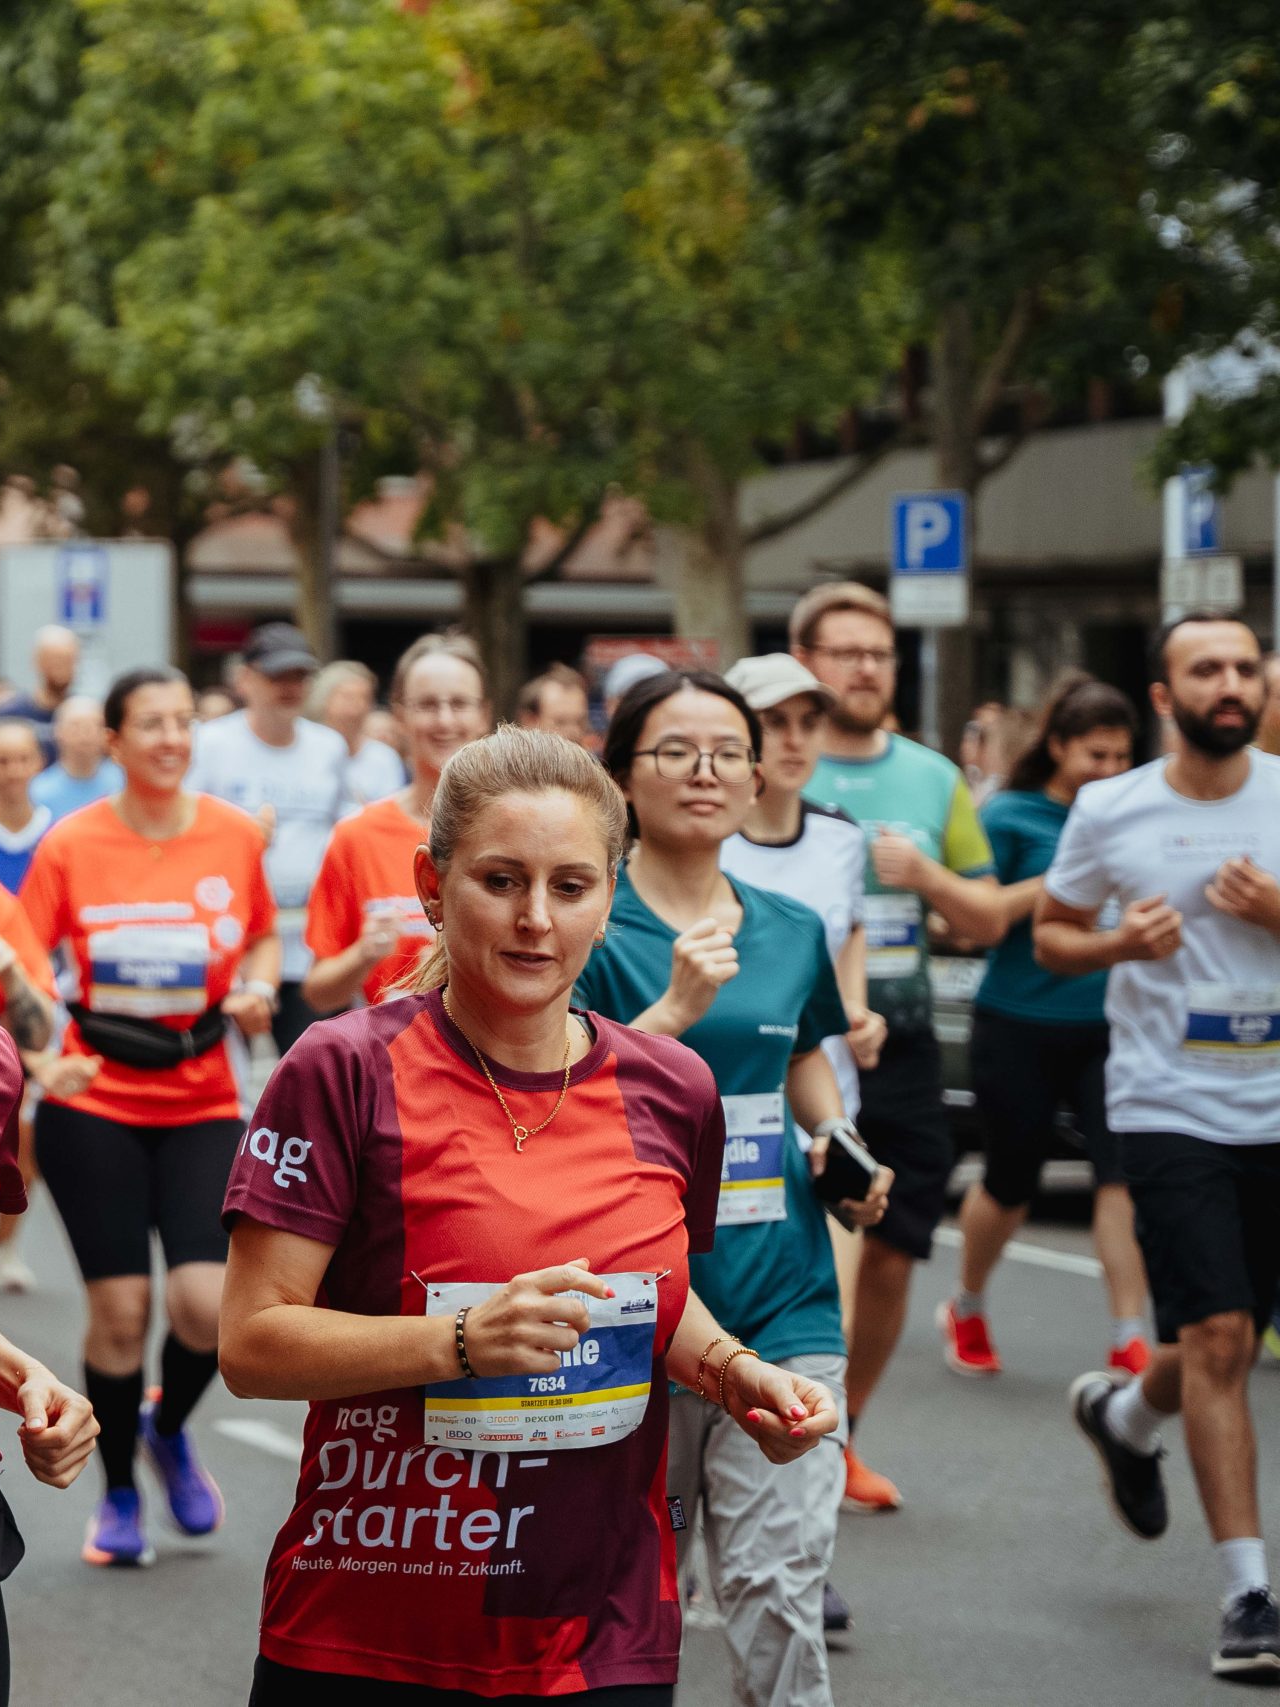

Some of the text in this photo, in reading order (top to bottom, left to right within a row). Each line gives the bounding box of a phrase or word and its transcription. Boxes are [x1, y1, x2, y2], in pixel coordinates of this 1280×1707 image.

[904, 500, 951, 569] P
[240, 1127, 313, 1188] ag
[528, 1376, 567, 1393] 7634
[520, 1399, 548, 1408] STARTZEIT
[563, 1397, 574, 1405] UHR
[335, 1405, 400, 1442] nag
[532, 1429, 547, 1438] dm
[448, 1430, 473, 1439] BDO
[303, 1495, 535, 1551] starter
[291, 1556, 526, 1577] Heute. Morgen und in Zukunft.
